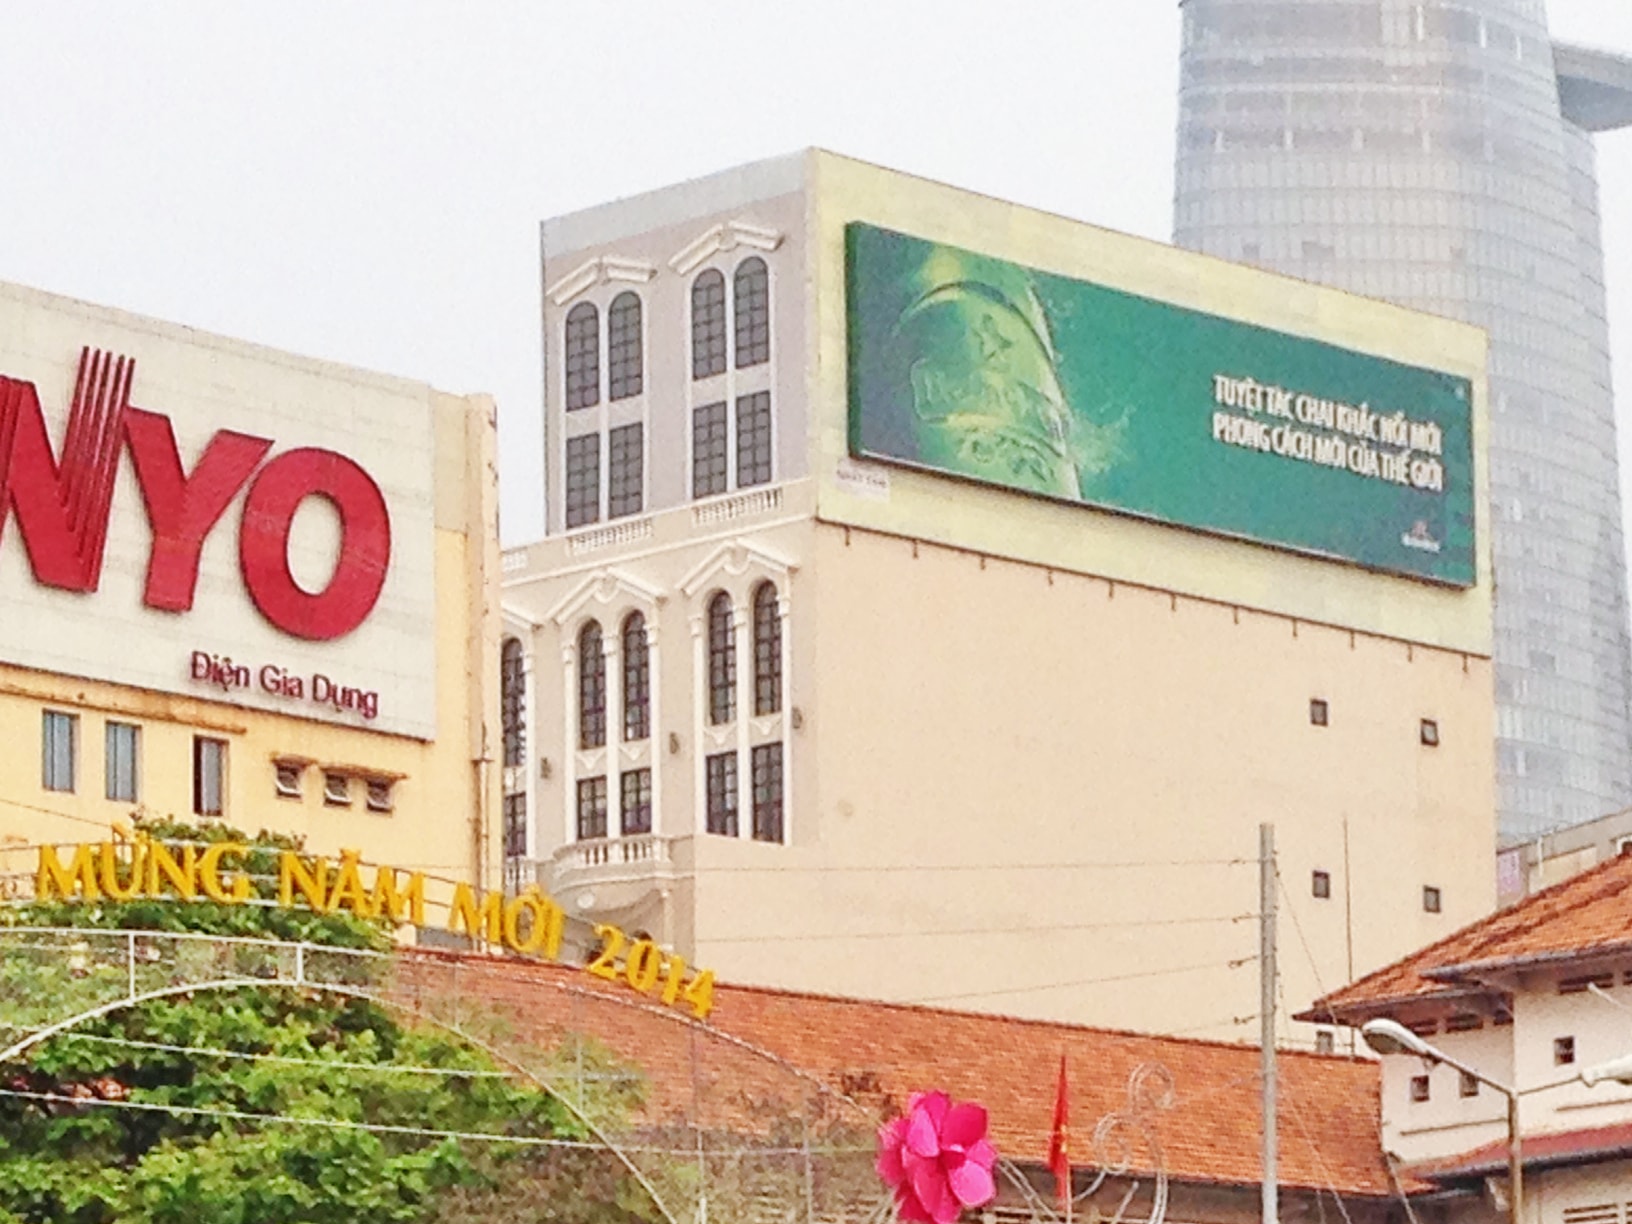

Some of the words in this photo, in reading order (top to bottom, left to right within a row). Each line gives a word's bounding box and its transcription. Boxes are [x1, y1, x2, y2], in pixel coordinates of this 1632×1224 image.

[1212, 412, 1270, 451] PHONG
[1271, 424, 1313, 461] CÁCH
[1295, 394, 1333, 428] CHAI
[191, 651, 250, 692] Điện
[260, 664, 304, 699] Gia
[312, 674, 379, 719] Dụng
[280, 848, 425, 927] NĂM
[587, 925, 716, 1019] 2014
